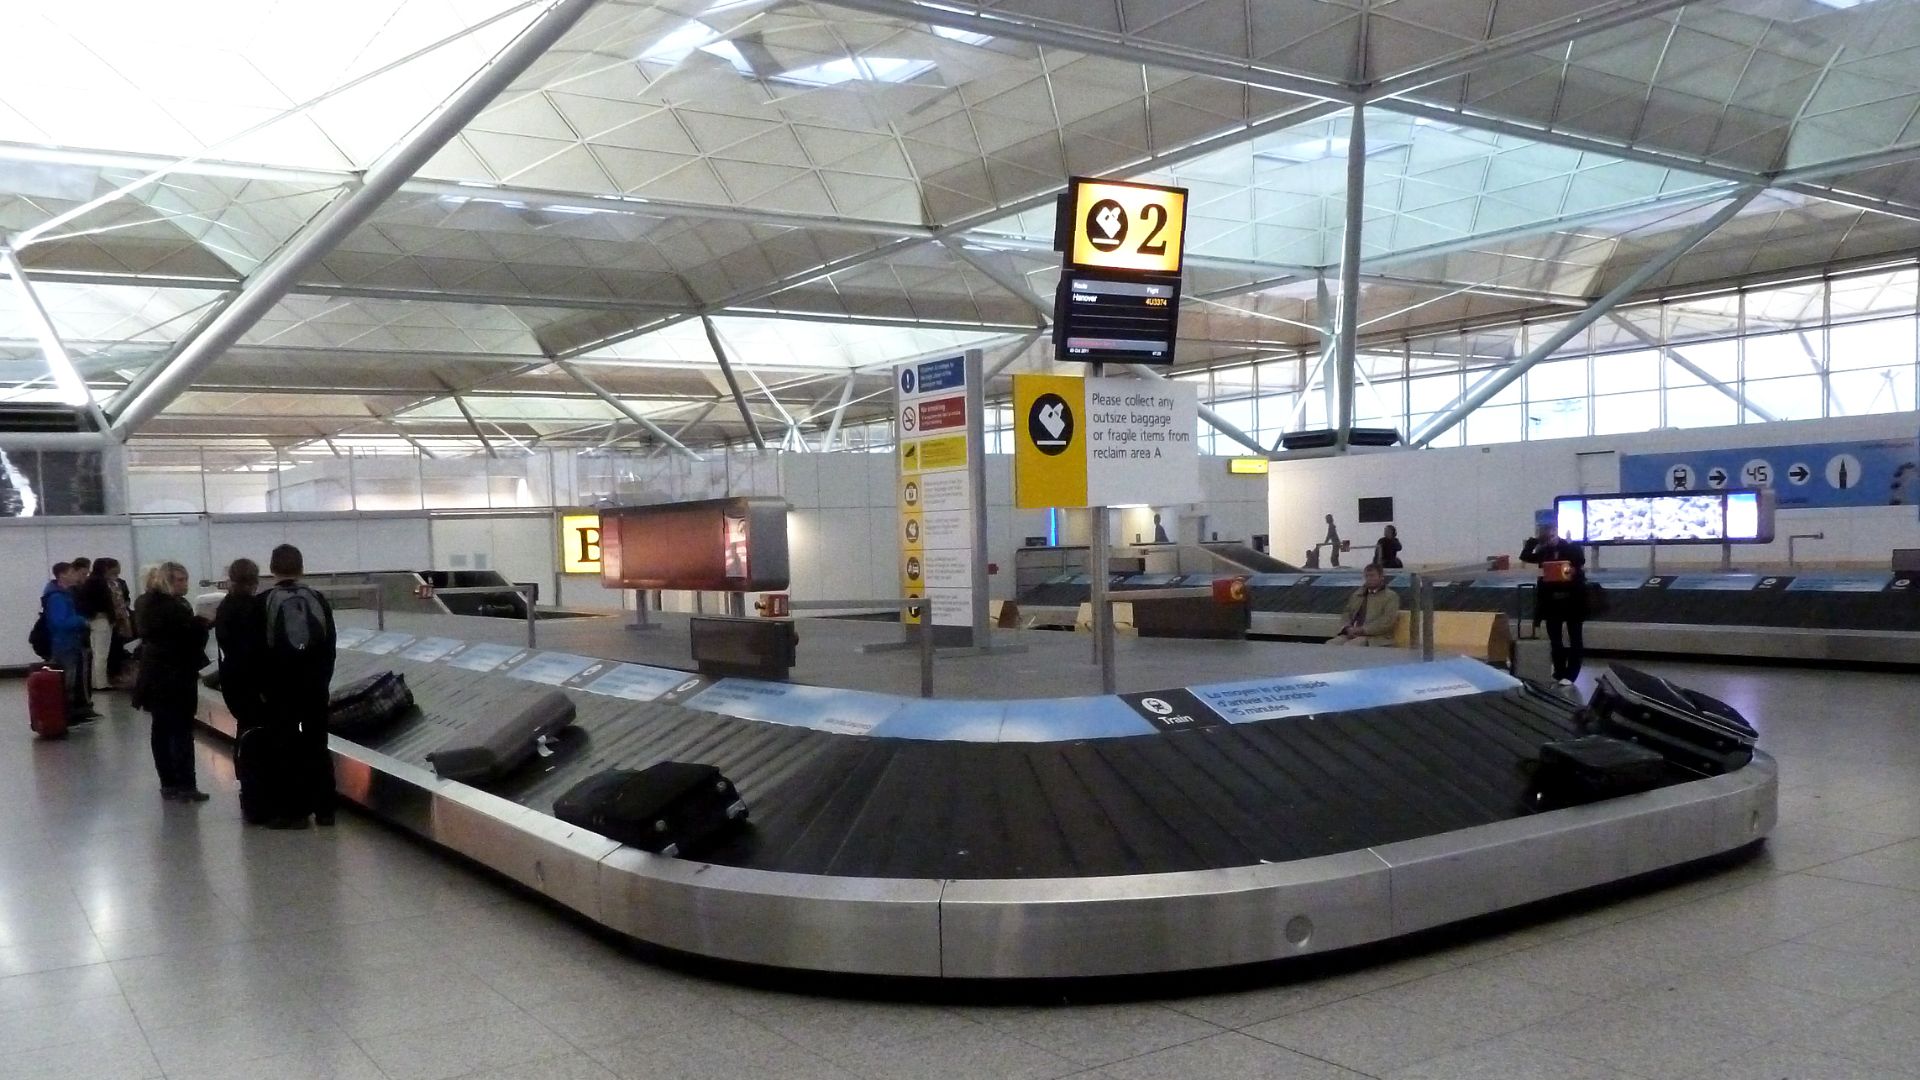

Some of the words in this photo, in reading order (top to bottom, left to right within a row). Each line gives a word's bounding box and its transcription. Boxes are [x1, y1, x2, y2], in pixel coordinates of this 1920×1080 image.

[1136, 203, 1168, 256] 2
[1072, 293, 1098, 303] Hanover
[1092, 392, 1122, 406] Please
[1125, 394, 1155, 407] collect
[1158, 398, 1175, 410] any
[1093, 412, 1127, 424] outsize
[1130, 411, 1172, 427] baggage
[1093, 431, 1104, 441] or
[1108, 428, 1137, 444] fragile
[1140, 429, 1165, 441] items
[1168, 429, 1190, 442] from
[1093, 446, 1127, 459] reclaim
[1130, 448, 1151, 459] area
[1154, 447, 1162, 458] A
[1747, 465, 1768, 482] 45
[1245, 704, 1290, 714] minutes
[1157, 715, 1195, 725] Train
